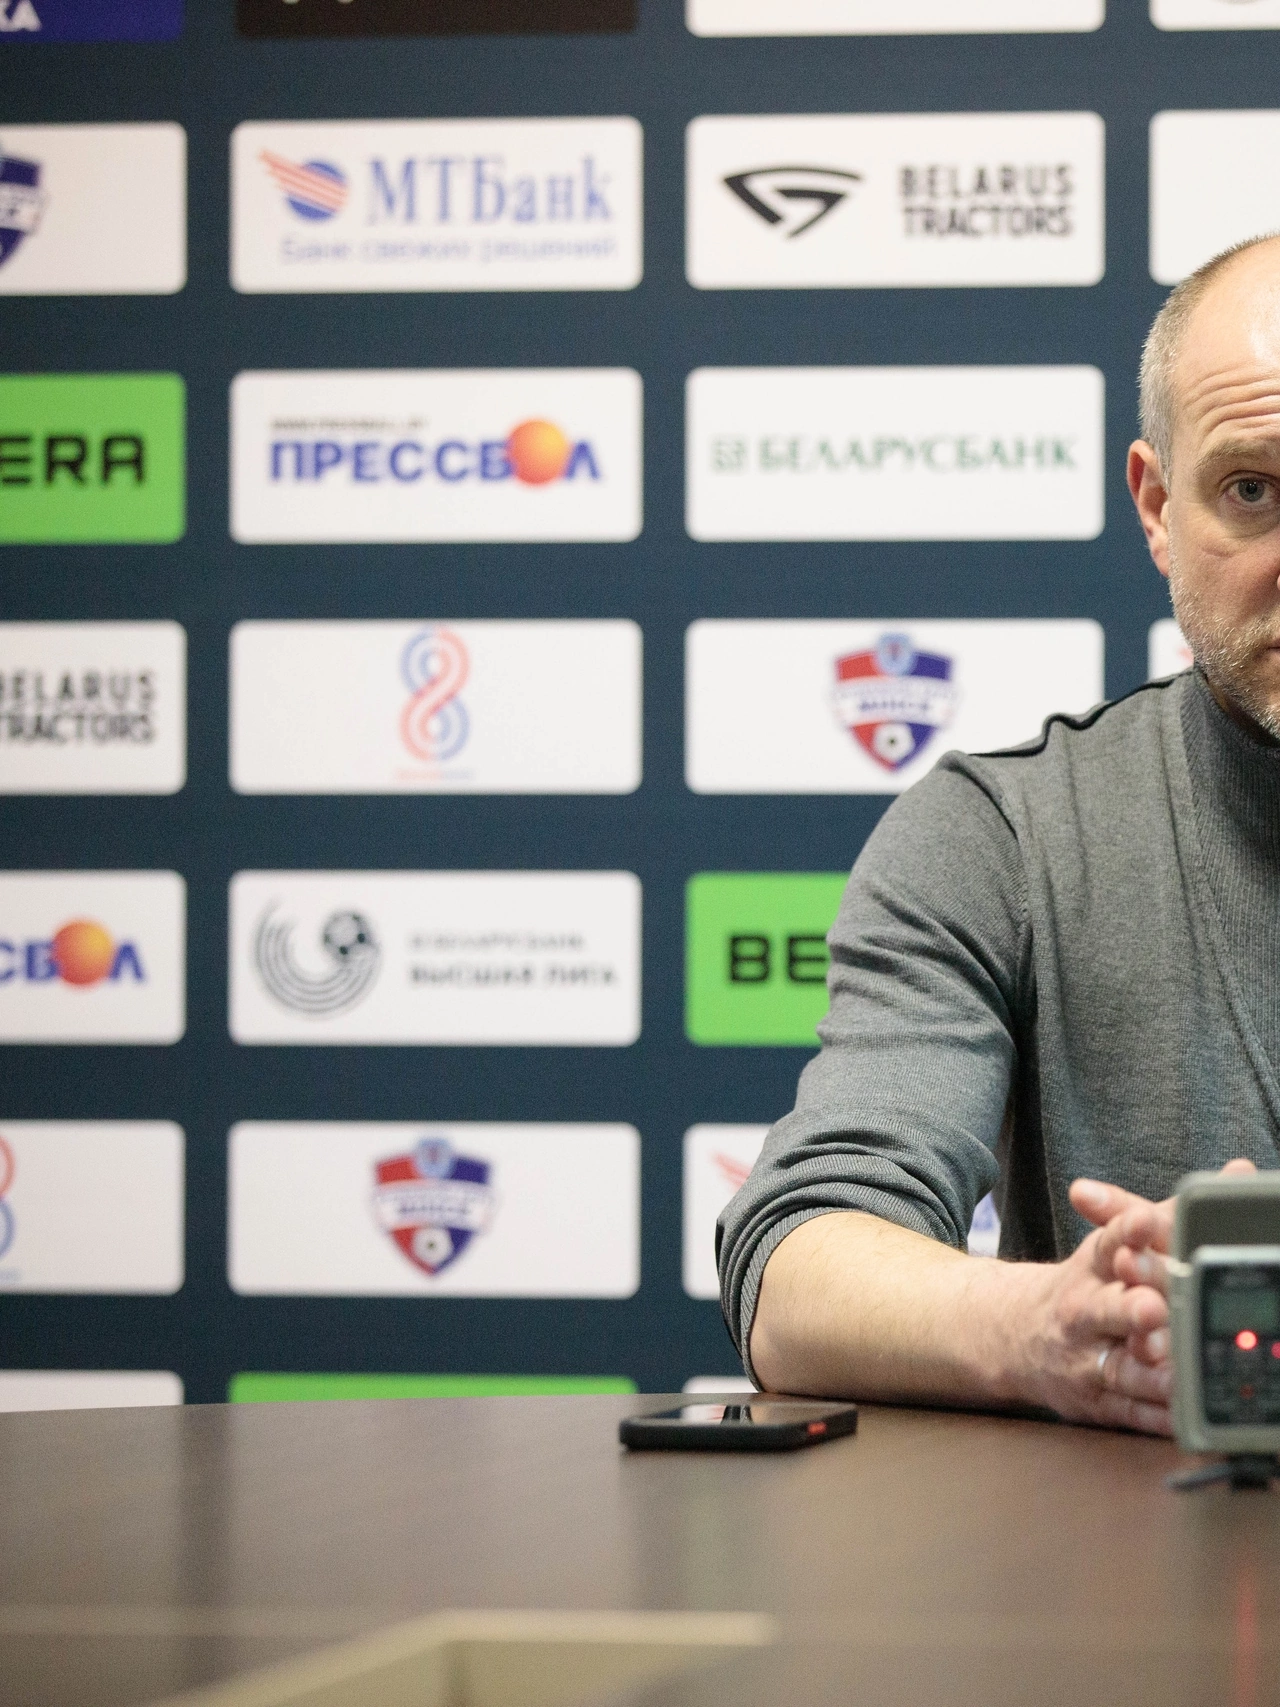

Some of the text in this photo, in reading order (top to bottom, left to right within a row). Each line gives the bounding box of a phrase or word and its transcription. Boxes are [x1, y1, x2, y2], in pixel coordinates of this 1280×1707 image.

[900, 165, 1074, 198] BELARUS
[902, 206, 1074, 237] TRACTORS
[758, 435, 1078, 472] БЕЛАРУСБАНК
